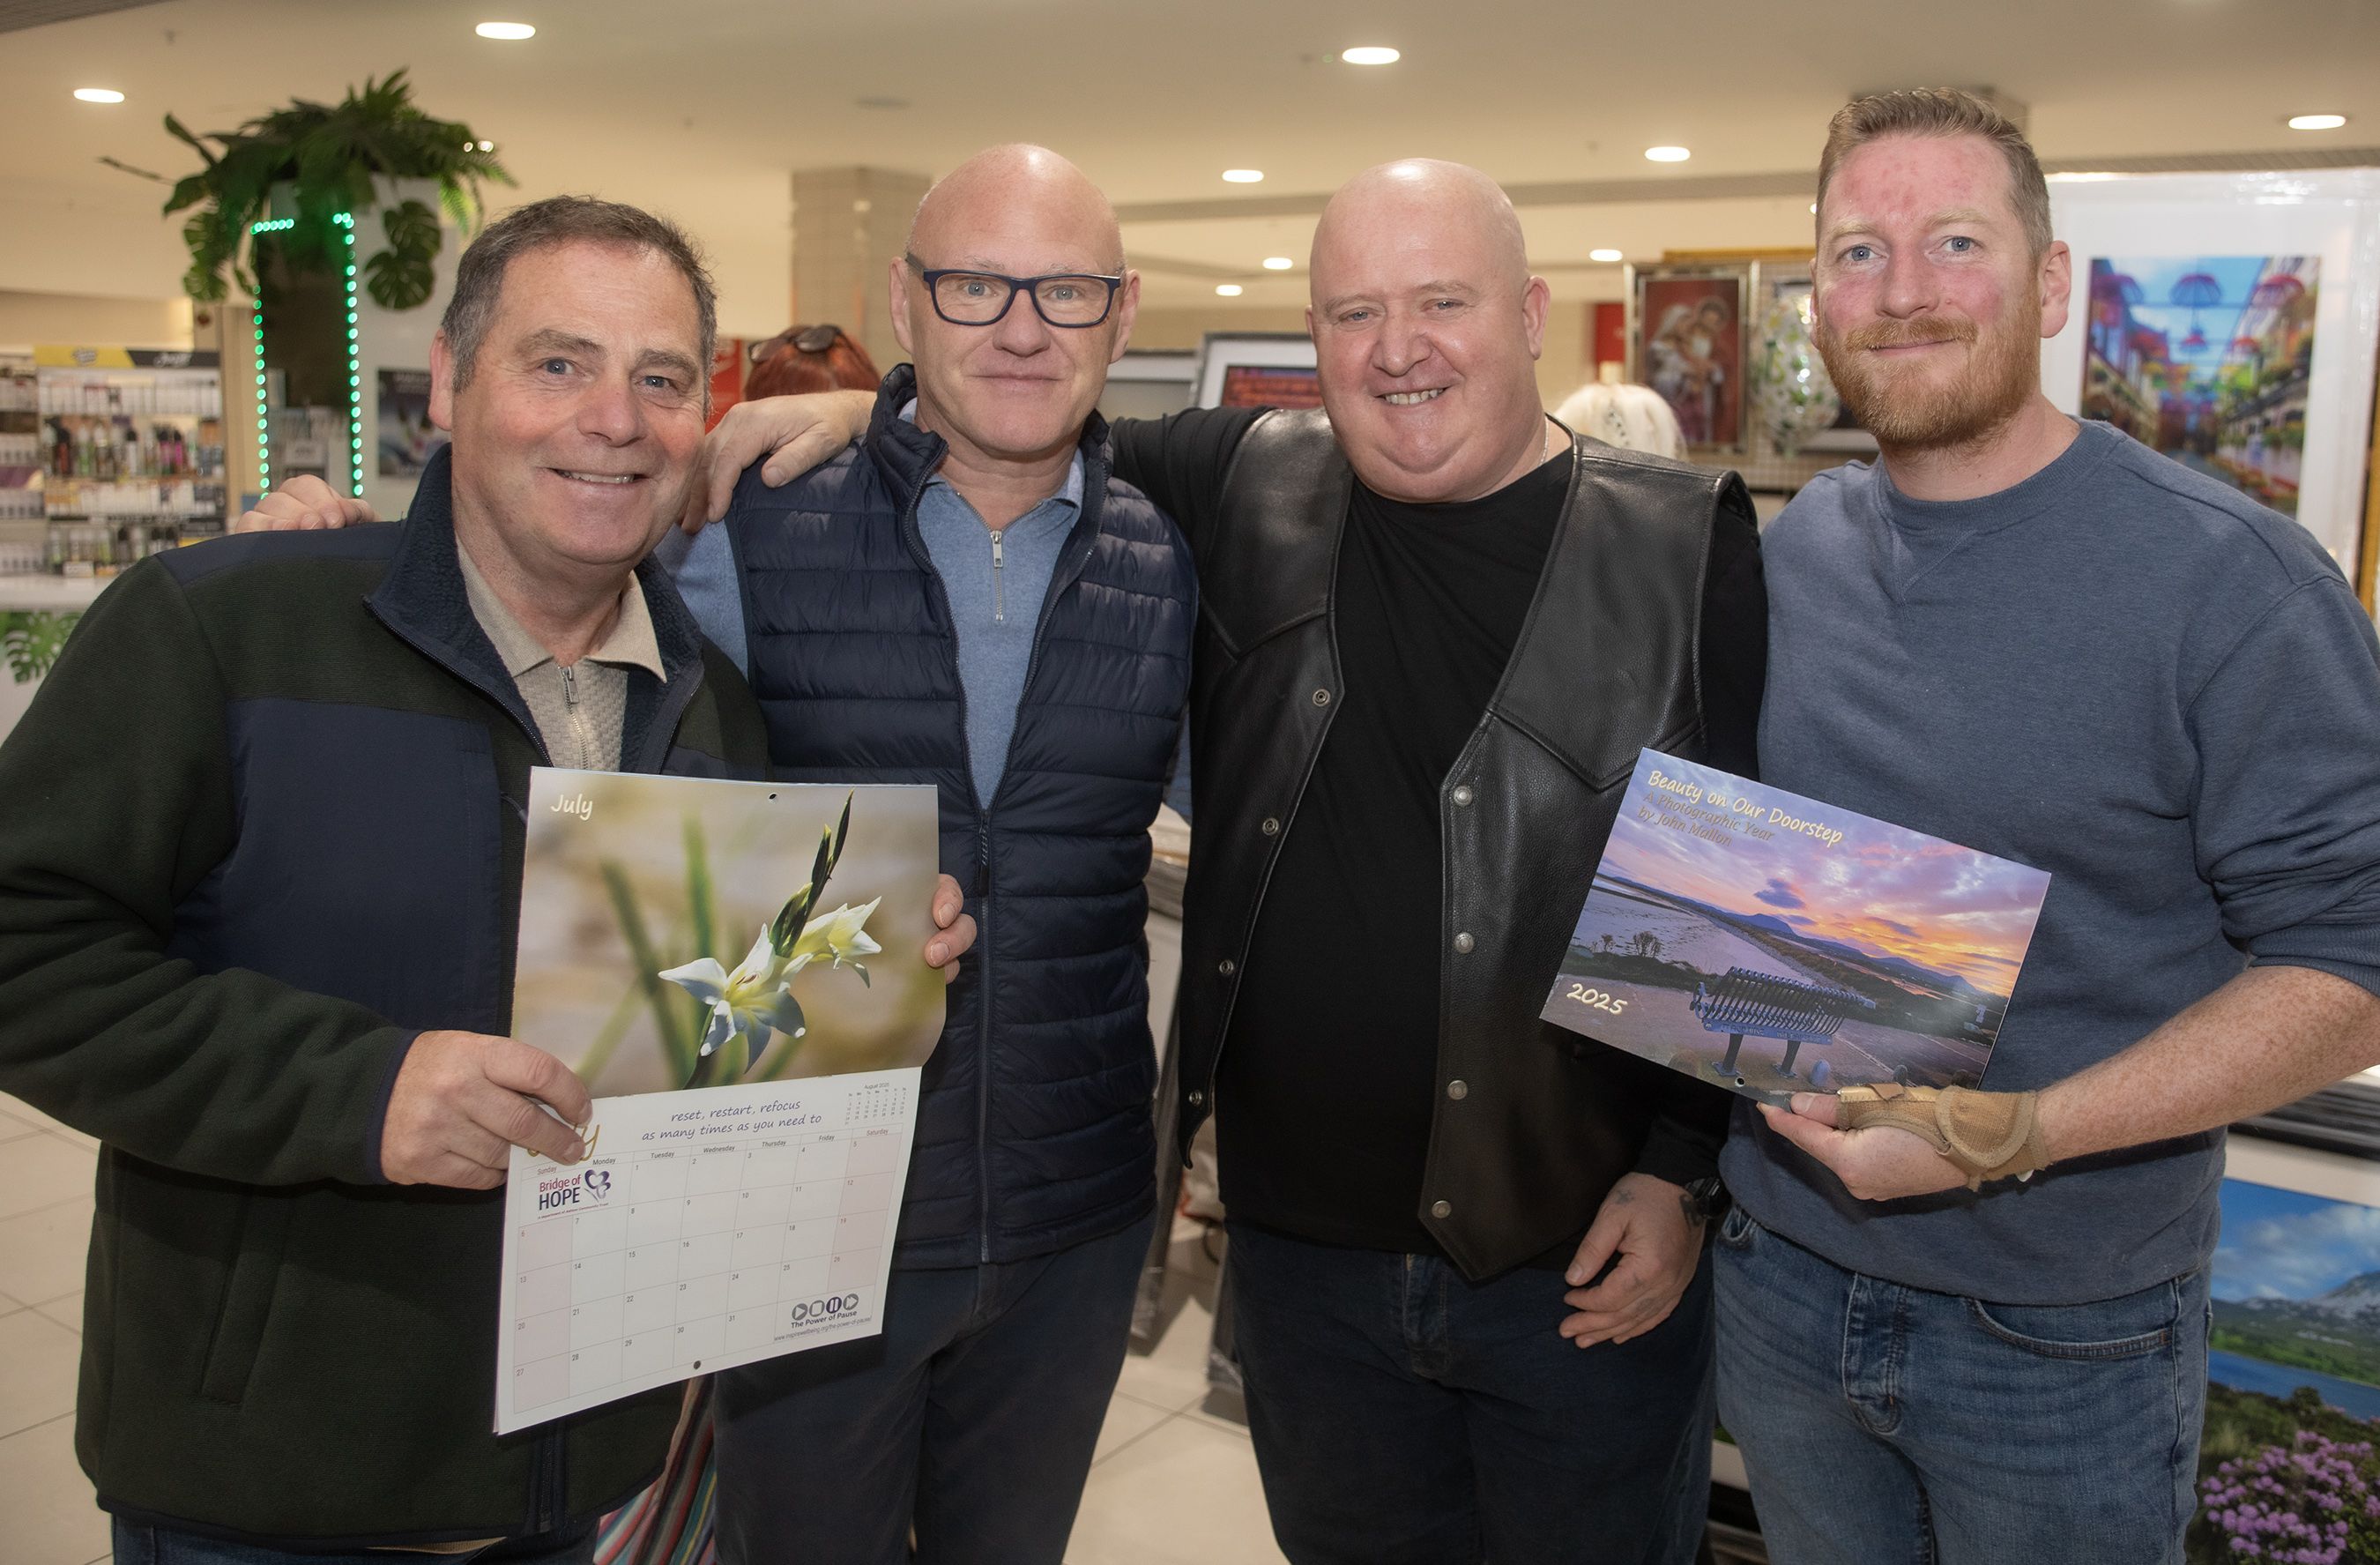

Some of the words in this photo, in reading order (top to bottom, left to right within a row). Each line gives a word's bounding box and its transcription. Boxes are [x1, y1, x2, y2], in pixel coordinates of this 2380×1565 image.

[550, 793, 592, 821] July
[1642, 791, 1654, 804] A
[1656, 794, 1741, 831] Photographic
[1744, 821, 1776, 841] Year
[1647, 770, 1703, 803] Beauty
[1707, 790, 1728, 809] on
[1733, 797, 1766, 819] Our
[1767, 807, 1843, 847] Doorstep
[1637, 805, 1654, 823] by
[1655, 811, 1686, 831] John
[1687, 822, 1733, 847] Mallon
[1566, 983, 1628, 1015] 2025
[671, 1109, 705, 1122] reset,
[710, 1104, 755, 1119] restart,
[760, 1099, 801, 1113] refocus
[642, 1132, 655, 1141] as
[660, 1127, 695, 1140] many
[700, 1123, 733, 1136] times
[737, 1122, 749, 1131] as
[754, 1120, 774, 1134] you
[778, 1114, 806, 1128] need
[810, 1114, 822, 1124] to
[537, 1166, 557, 1175] Sunday
[703, 1144, 736, 1154] Wednesday
[762, 1139, 787, 1148] Thursday
[818, 1134, 836, 1143] Friday
[539, 1177, 570, 1192] Bridge
[571, 1174, 582, 1186] of
[539, 1187, 581, 1211] HOPE
[679, 1283, 687, 1292] 23
[805, 1316, 827, 1325] Power
[837, 1310, 858, 1319] Pause
[516, 1368, 524, 1376] 27
